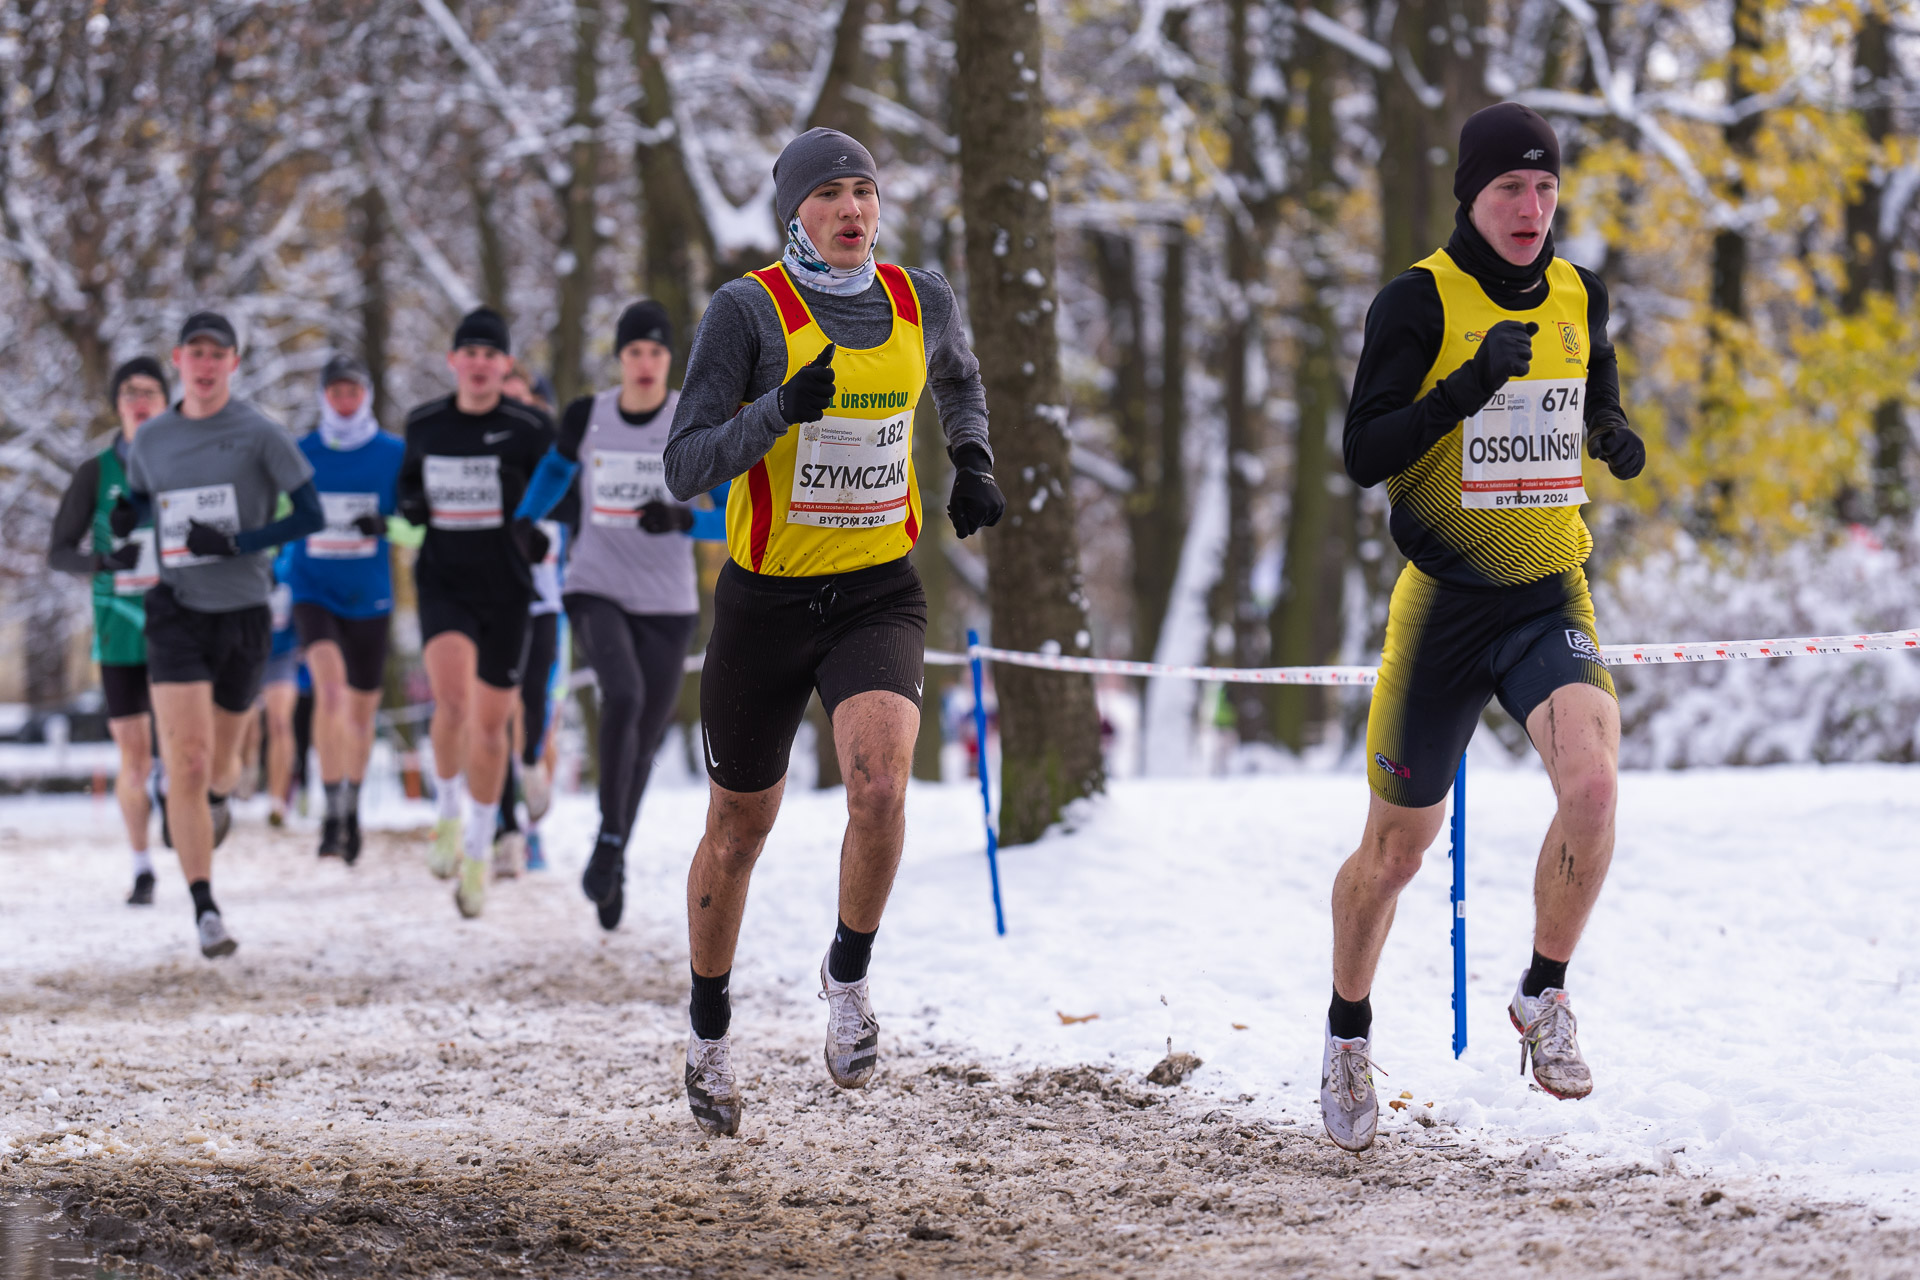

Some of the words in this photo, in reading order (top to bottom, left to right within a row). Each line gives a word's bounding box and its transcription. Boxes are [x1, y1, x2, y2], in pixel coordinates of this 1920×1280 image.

[1522, 149, 1545, 160] 4F
[841, 390, 909, 409] URSYNÓW
[1541, 387, 1579, 412] 674
[820, 427, 853, 436] Ministerstwo
[876, 420, 904, 447] 182
[1469, 428, 1580, 464] OSSOLIŃSKI
[799, 458, 905, 489] SZYMCZAK
[1496, 494, 1540, 505] BYTOM
[1543, 493, 1569, 504] 2024
[819, 516, 860, 526] BYTOM
[861, 514, 886, 526] 2024
